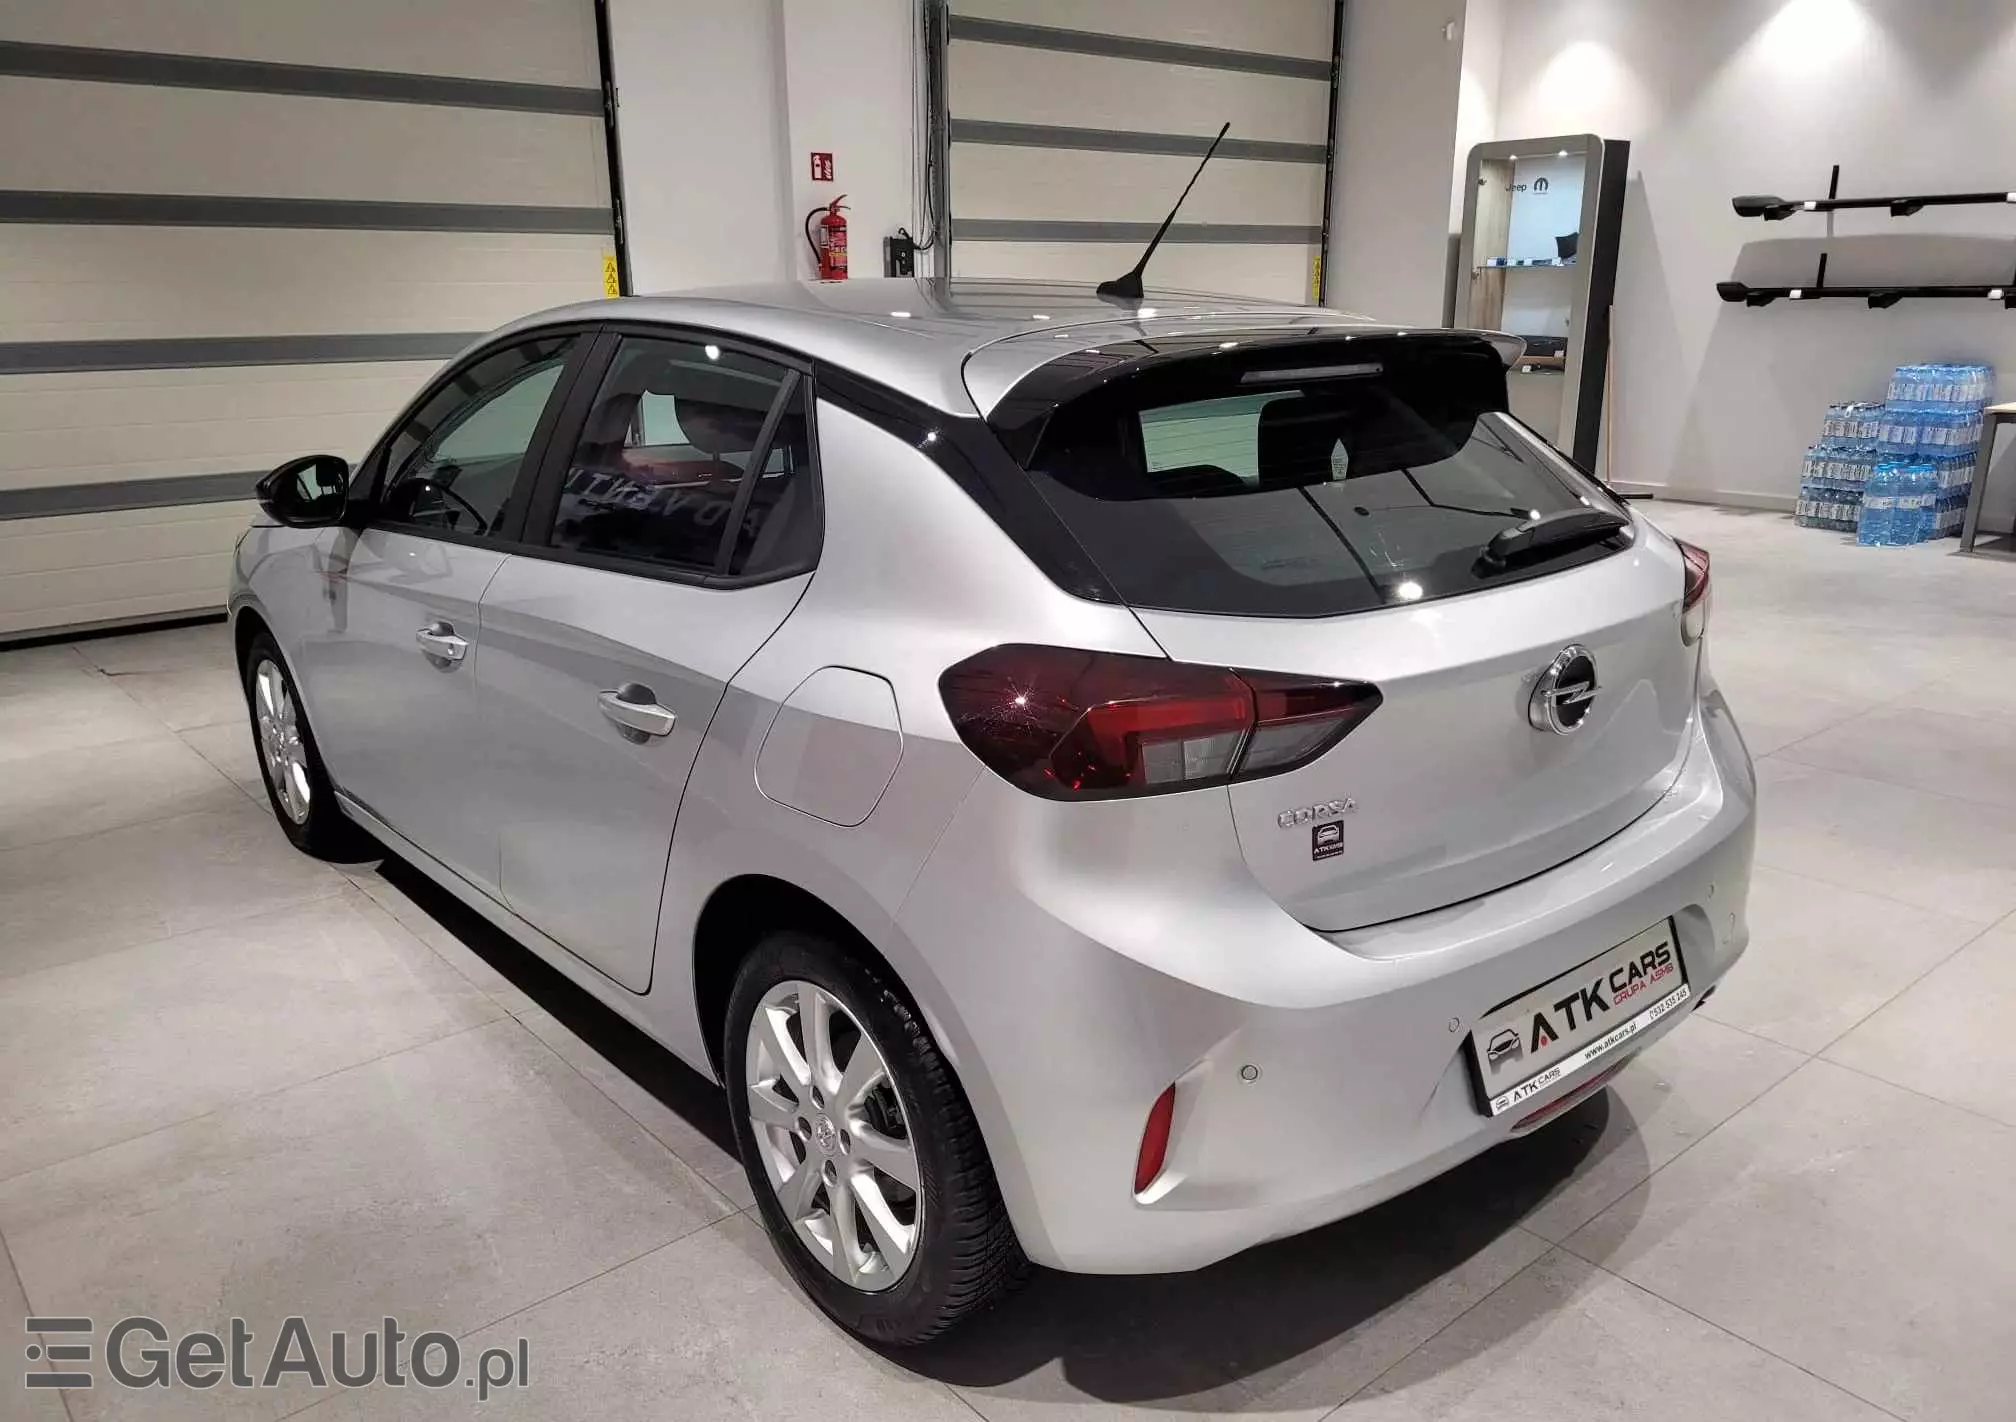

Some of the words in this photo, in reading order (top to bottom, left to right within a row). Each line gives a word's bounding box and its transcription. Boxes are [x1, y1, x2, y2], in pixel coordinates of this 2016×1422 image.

[1278, 797, 1358, 829] CORSA
[1530, 978, 1610, 1053] ATK
[1610, 941, 1671, 993] CARS
[1613, 980, 1647, 1006] GRUPA
[1514, 1079, 1539, 1102] ATK
[1538, 1067, 1561, 1085] CARS
[1584, 1022, 1638, 1060] www.atkcars.pl
